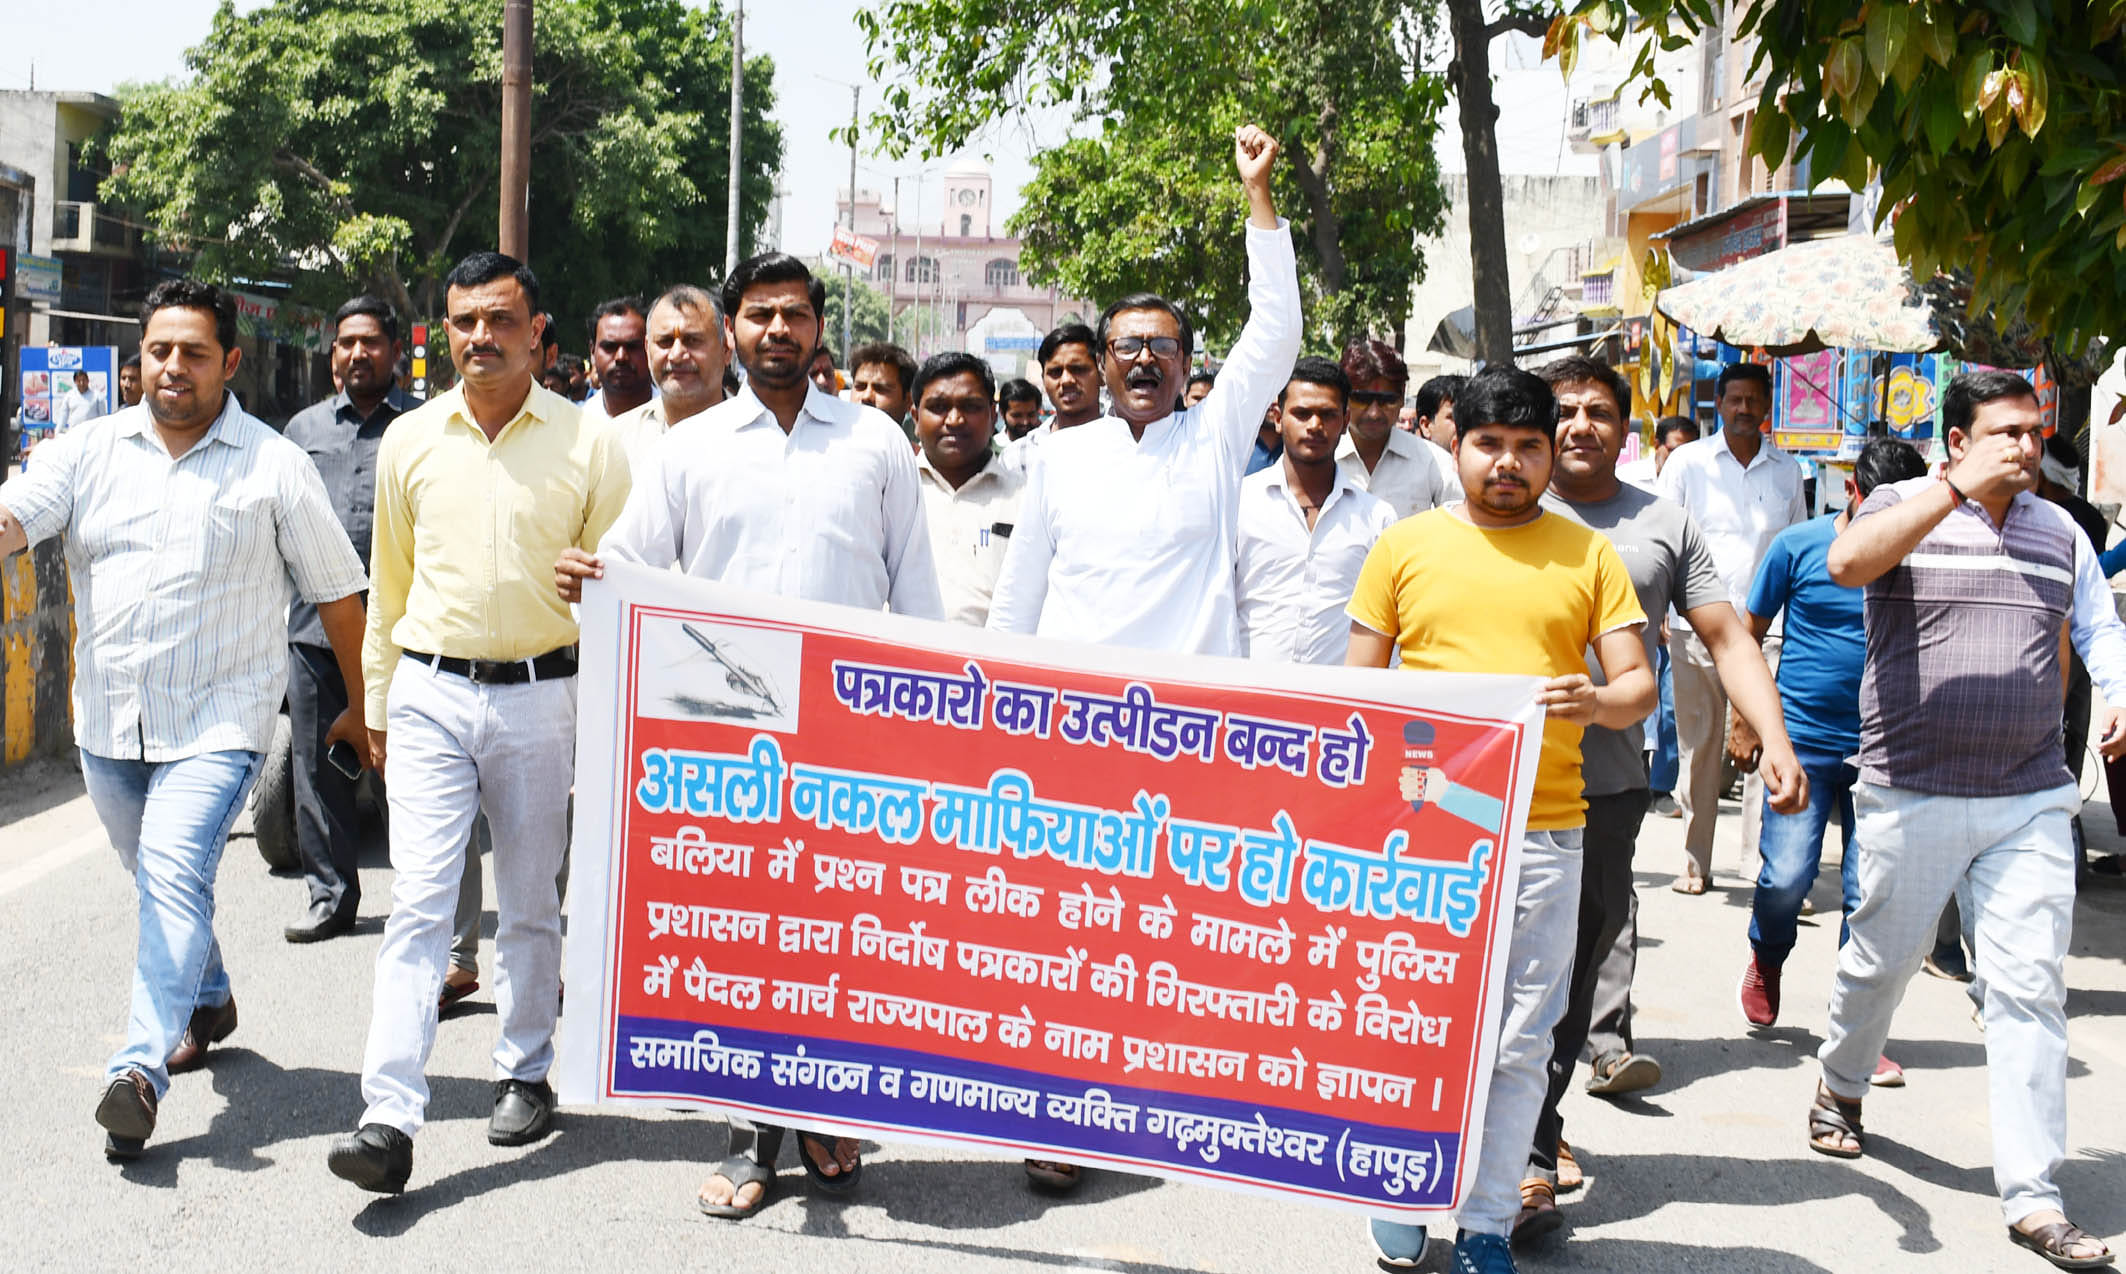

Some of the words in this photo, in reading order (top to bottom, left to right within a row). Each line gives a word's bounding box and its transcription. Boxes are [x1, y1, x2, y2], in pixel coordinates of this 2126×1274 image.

[832, 659, 988, 729] पत्रकारो
[994, 678, 1057, 735] का
[1059, 681, 1219, 763] उत्पीडन
[1224, 711, 1318, 777] बन्द
[1318, 711, 1373, 788] हो
[1404, 749, 1434, 760] NEWS
[636, 733, 784, 822] असली
[790, 762, 931, 844] नकल
[930, 768, 1170, 878] माफियाओं
[1167, 818, 1240, 893] पर
[1238, 809, 1302, 906] हो
[1302, 829, 1493, 936] कार्रवाई
[650, 826, 755, 878] बलिया
[769, 838, 805, 883] में
[814, 853, 886, 895] प्रश्न
[901, 866, 950, 905] पत्र
[965, 866, 1044, 919] लीक
[1058, 882, 1125, 933] होने
[1139, 895, 1177, 940] के
[1190, 912, 1296, 965] मामले
[1308, 924, 1346, 969] में
[1356, 932, 1460, 991] पुलिस
[643, 954, 679, 998] में
[684, 956, 765, 1010] पैदल
[772, 973, 839, 1017] मार्च
[848, 989, 991, 1044] राज्यपाल
[999, 1003, 1036, 1050] के
[1044, 1020, 1112, 1065] नाम
[1123, 1035, 1248, 1081] प्रशासन
[1258, 1048, 1306, 1091] को
[1317, 1062, 1416, 1108] ज्ञापन
[647, 901, 770, 944] प्रशासन
[778, 914, 843, 955] द्वारा
[851, 913, 948, 972] निर्दोष
[957, 941, 1088, 992] पत्रकारों
[1090, 954, 1137, 1001] की
[1146, 960, 1298, 1027] गिरफ्तारी
[1308, 990, 1347, 1031] के
[1355, 993, 1451, 1048] विरोध
[630, 1030, 764, 1079] समाजिक
[771, 1044, 873, 1096] संगठन
[879, 1066, 903, 1098] व
[910, 1069, 1040, 1119] गणमान्य
[1047, 1088, 1137, 1136] व्यक्ति
[1147, 1106, 1328, 1167] गढ़मुक्तेश्वर
[1336, 1127, 1443, 1194] (हापुड़)
